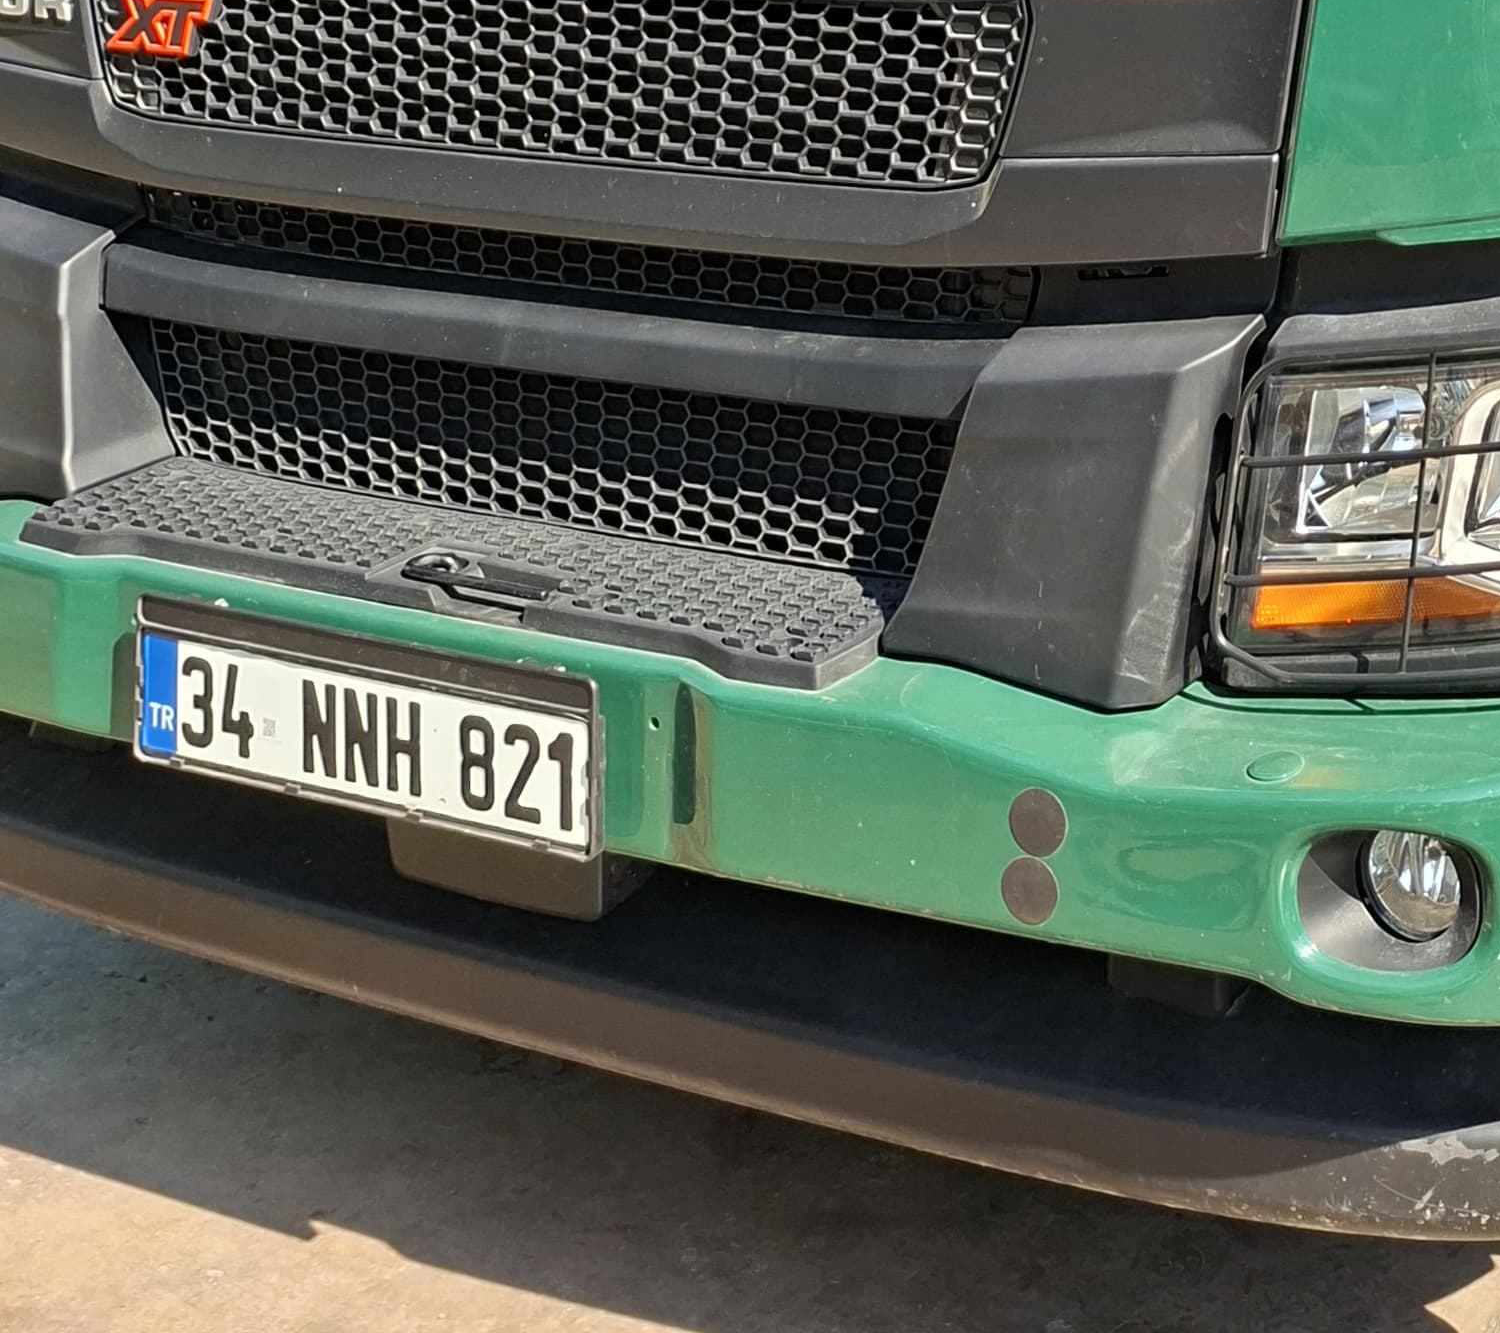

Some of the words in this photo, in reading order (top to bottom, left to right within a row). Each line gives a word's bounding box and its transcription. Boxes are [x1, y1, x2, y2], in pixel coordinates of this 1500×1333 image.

[150, 701, 175, 732] TR
[182, 655, 255, 759] 34
[302, 678, 422, 797] NNH
[458, 714, 575, 832] 821
